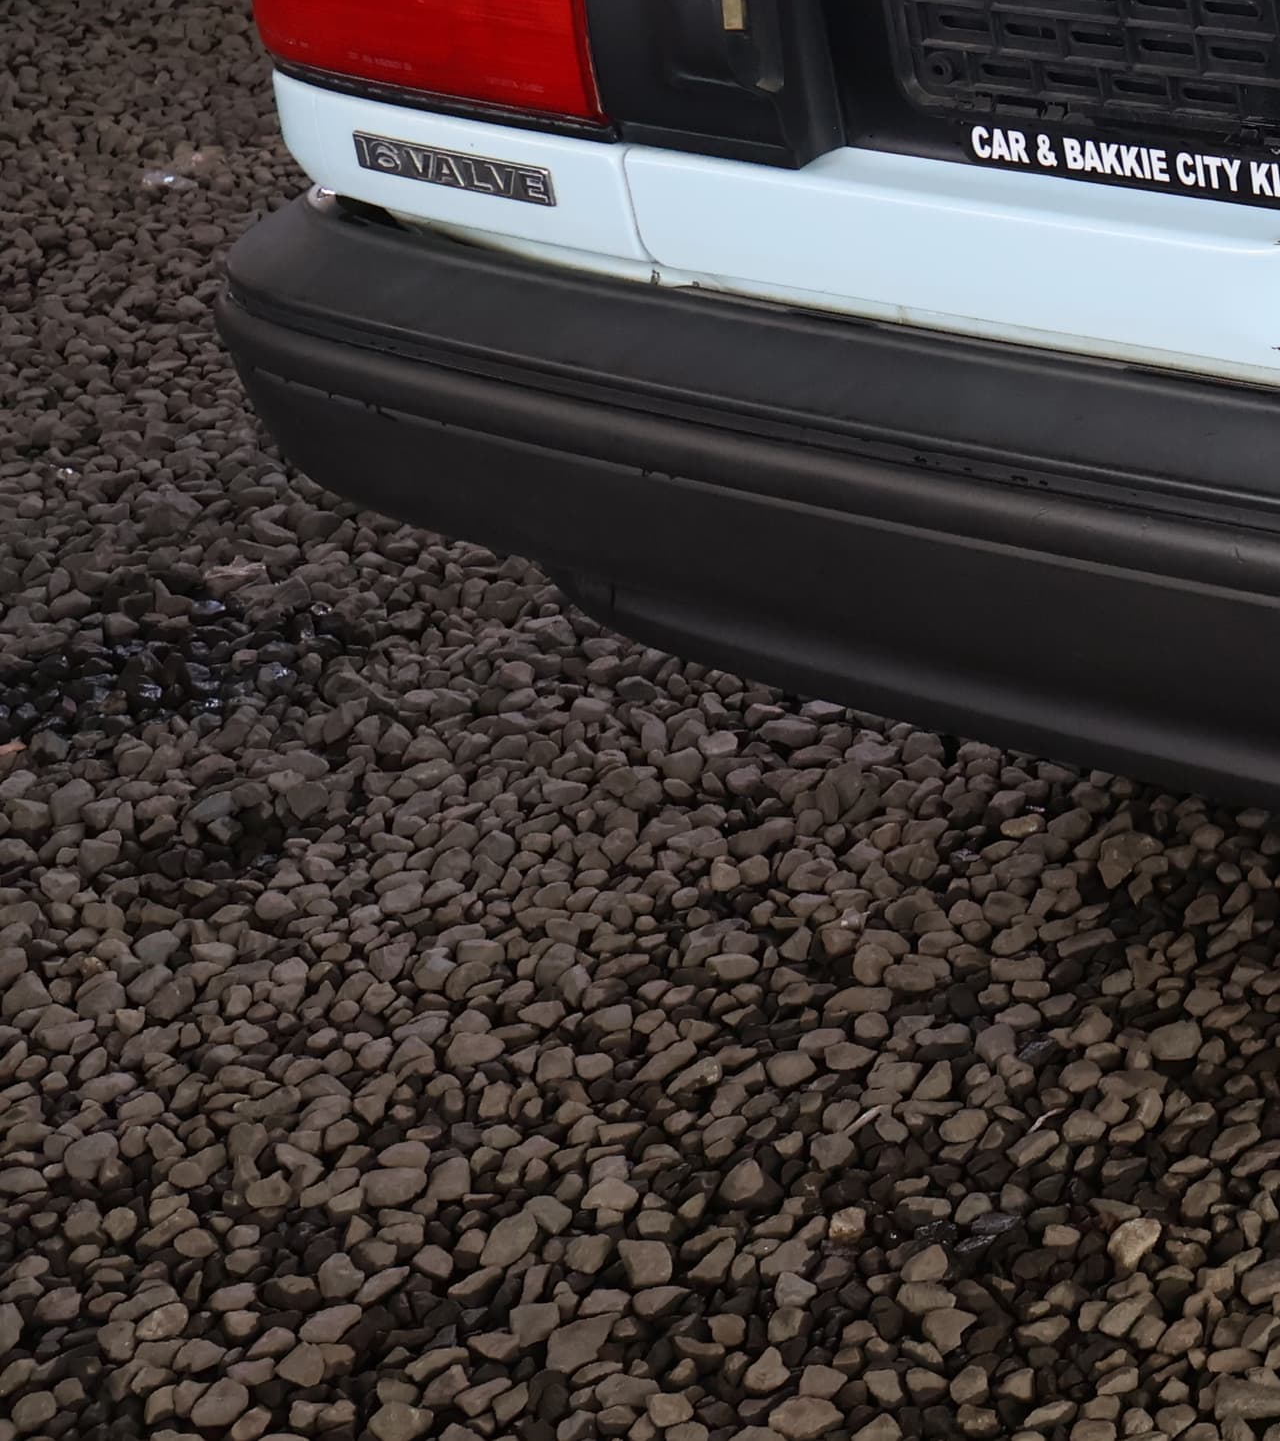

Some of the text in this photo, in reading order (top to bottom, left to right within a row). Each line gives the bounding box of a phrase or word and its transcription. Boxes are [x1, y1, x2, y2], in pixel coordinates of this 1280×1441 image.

[971, 125, 1029, 164] CAR
[1036, 134, 1058, 168] &
[1063, 137, 1170, 183] BAKKIE
[1176, 152, 1241, 192] CITY
